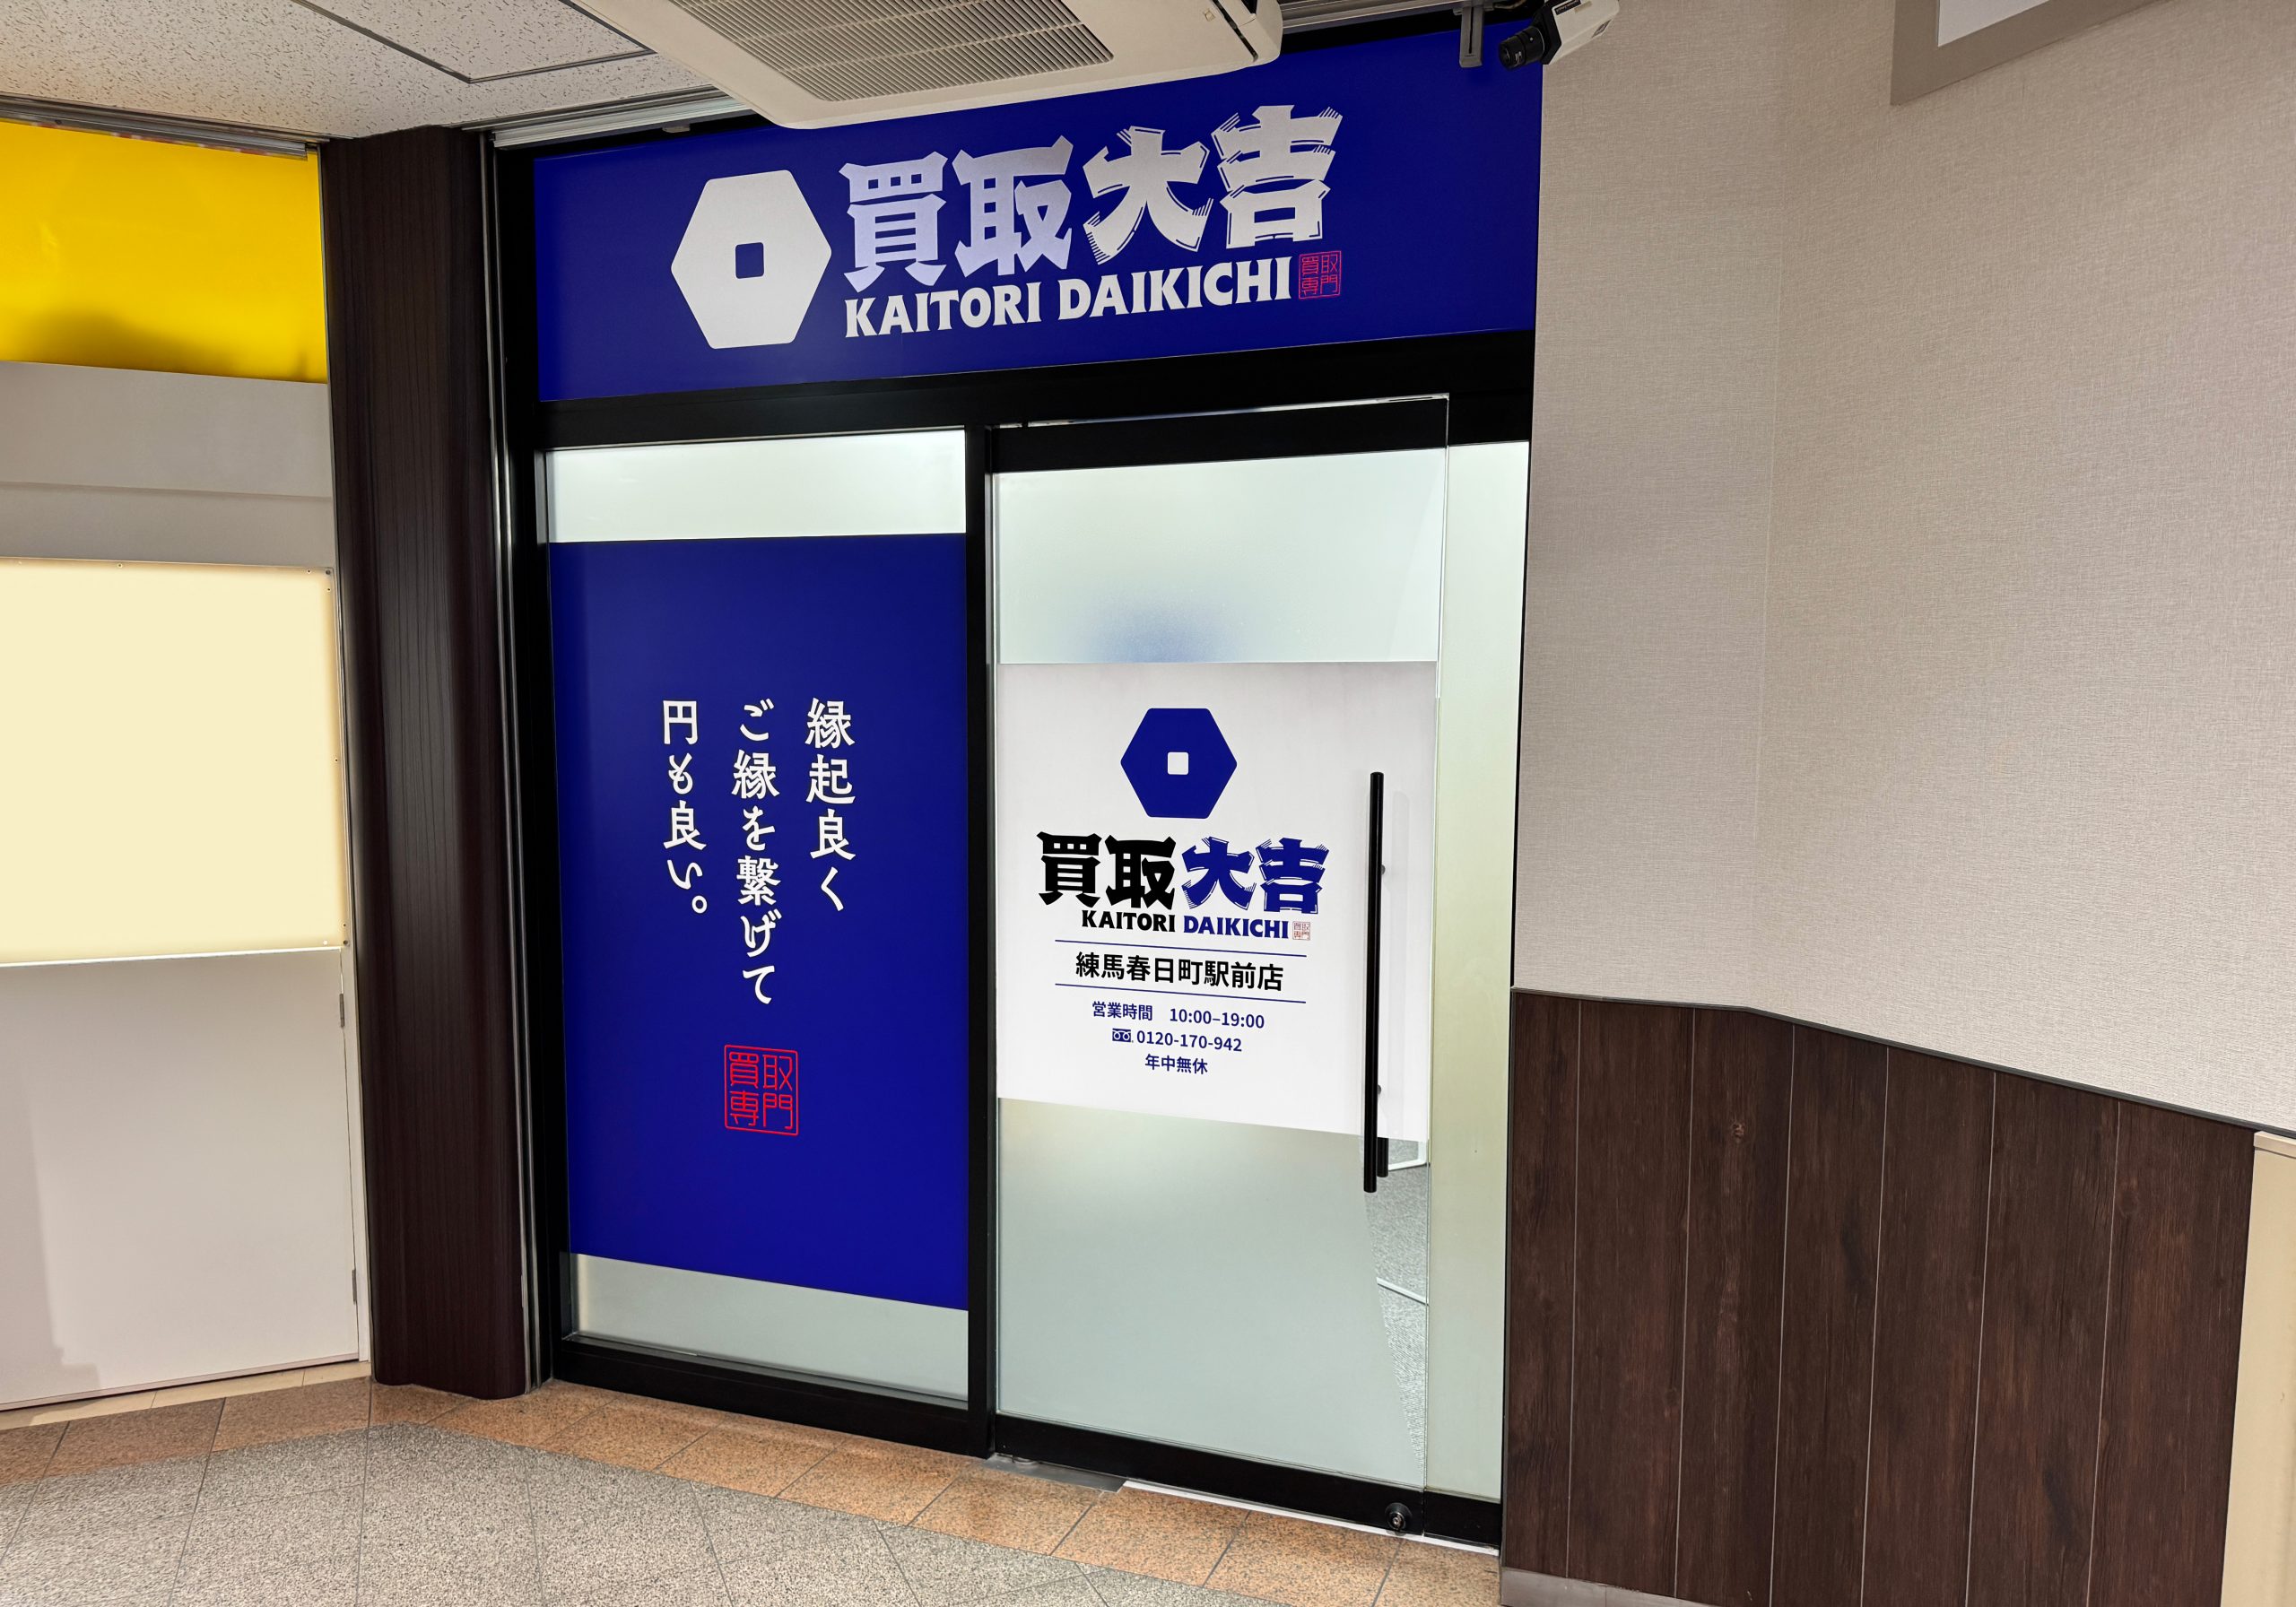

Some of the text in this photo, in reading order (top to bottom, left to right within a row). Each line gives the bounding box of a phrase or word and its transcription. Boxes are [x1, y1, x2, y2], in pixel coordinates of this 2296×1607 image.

[839, 104, 1344, 290] 買取大吉
[844, 256, 1292, 338] KAITORI DAIKICHI
[662, 699, 708, 914] 円も良い。
[805, 698, 856, 912] 縁起良く
[731, 698, 782, 1004] ご縁を繋げて
[1036, 831, 1329, 915] 買取大吉
[1081, 909, 1289, 939] KAITORI DAIKICHI
[1075, 951, 1284, 992] 練馬春日町駅前店
[1091, 1001, 1153, 1021] 営業時間
[1136, 1030, 1243, 1052] 0120-170-942
[1144, 1054, 1208, 1074] 年中無休
